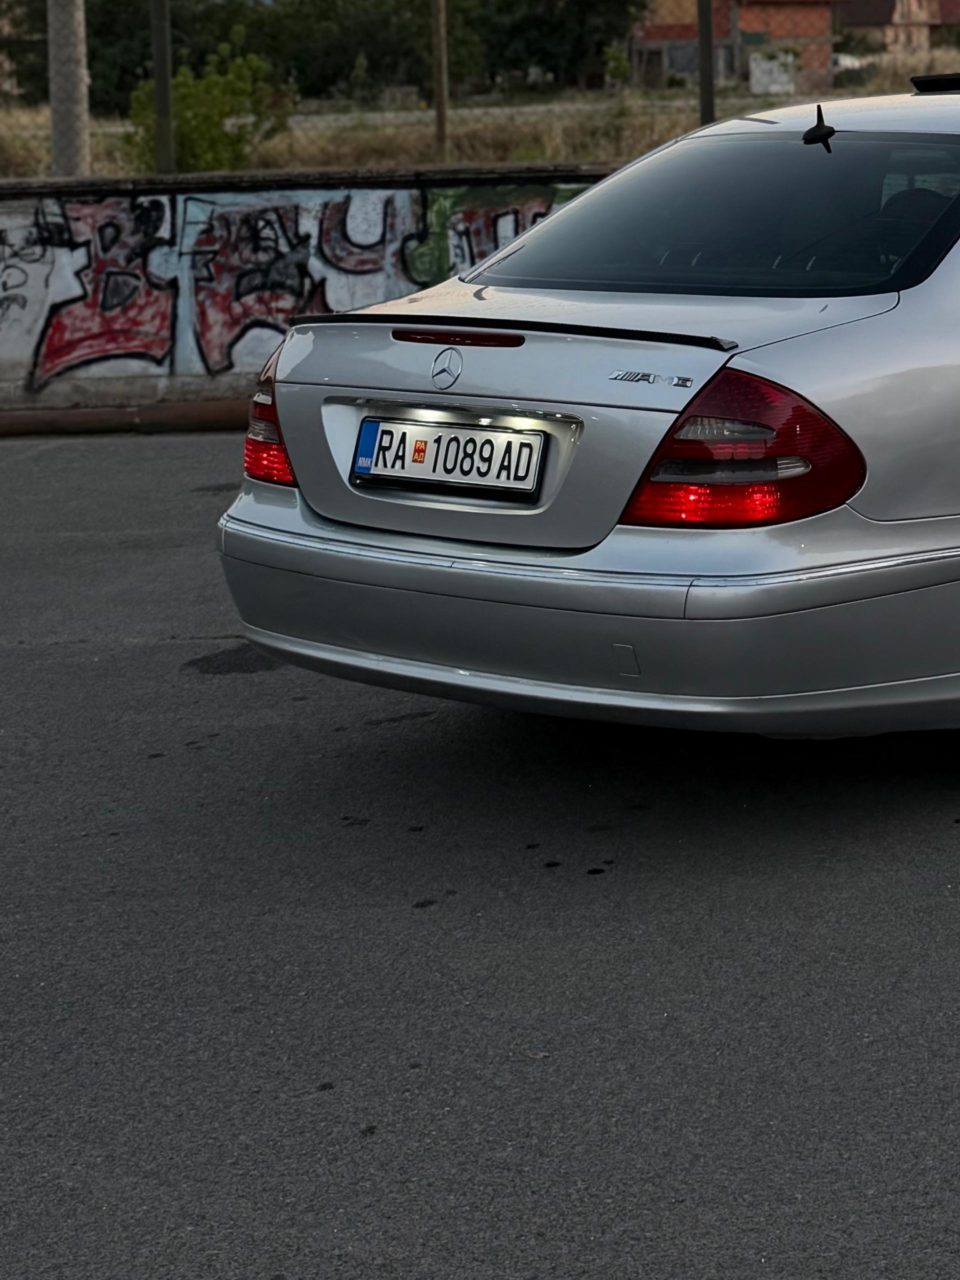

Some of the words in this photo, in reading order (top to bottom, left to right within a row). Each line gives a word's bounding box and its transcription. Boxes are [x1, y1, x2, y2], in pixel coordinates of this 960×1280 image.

[375, 429, 407, 470] RA
[432, 434, 494, 478] 1089
[496, 440, 533, 481] AD
